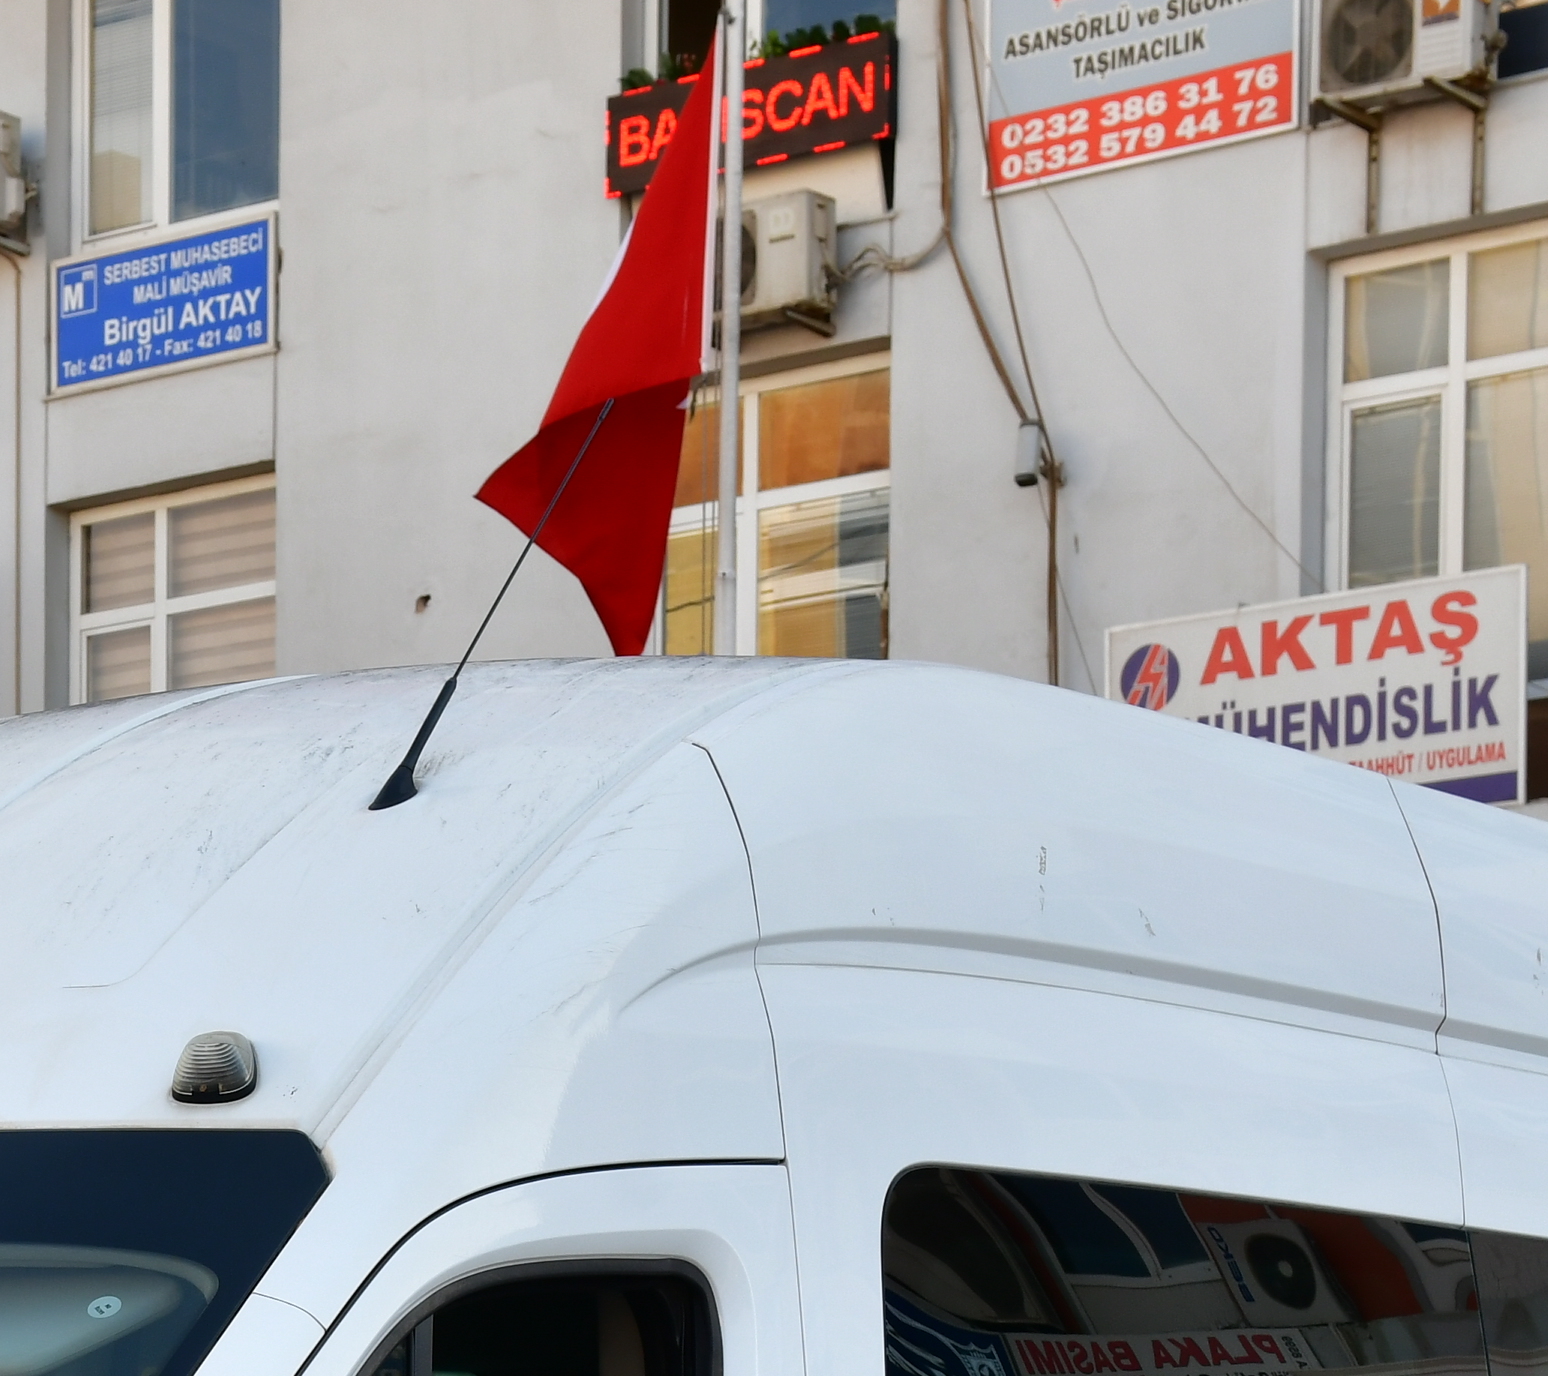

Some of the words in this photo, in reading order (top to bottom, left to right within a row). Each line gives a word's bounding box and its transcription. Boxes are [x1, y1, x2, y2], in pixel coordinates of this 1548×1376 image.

[1004, 4, 1131, 60] ASANSÖRLÜ
[1134, 10, 1160, 30] ve
[1072, 28, 1206, 79] TAŞIMACILIK
[1001, 108, 1090, 150] 0232
[1099, 90, 1168, 128] 386
[1177, 78, 1223, 109] 31
[1234, 63, 1279, 98] 76
[1001, 137, 1089, 179] 0532
[1099, 123, 1165, 158] 579
[1175, 112, 1223, 141] 44
[1234, 97, 1279, 127] 72
[103, 253, 168, 286] SERBEST
[170, 227, 263, 271] MUHASEBECİ
[133, 276, 167, 304] MALİ
[169, 263, 232, 296] MÜŞAVİR
[104, 305, 174, 346] Birgül
[178, 286, 263, 330] AKTAY
[62, 359, 86, 379] Tel:
[89, 353, 113, 373] 421
[116, 350, 134, 367] 40
[137, 343, 153, 362] 17
[164, 337, 193, 357] Fax:
[197, 329, 222, 350] 421
[225, 324, 243, 343] 40
[245, 319, 263, 338] 18
[1199, 590, 1480, 687] AKTAŞ
[1183, 665, 1501, 753] ÜHENDİSLİK
[1426, 742, 1506, 772] UYGULAMA
